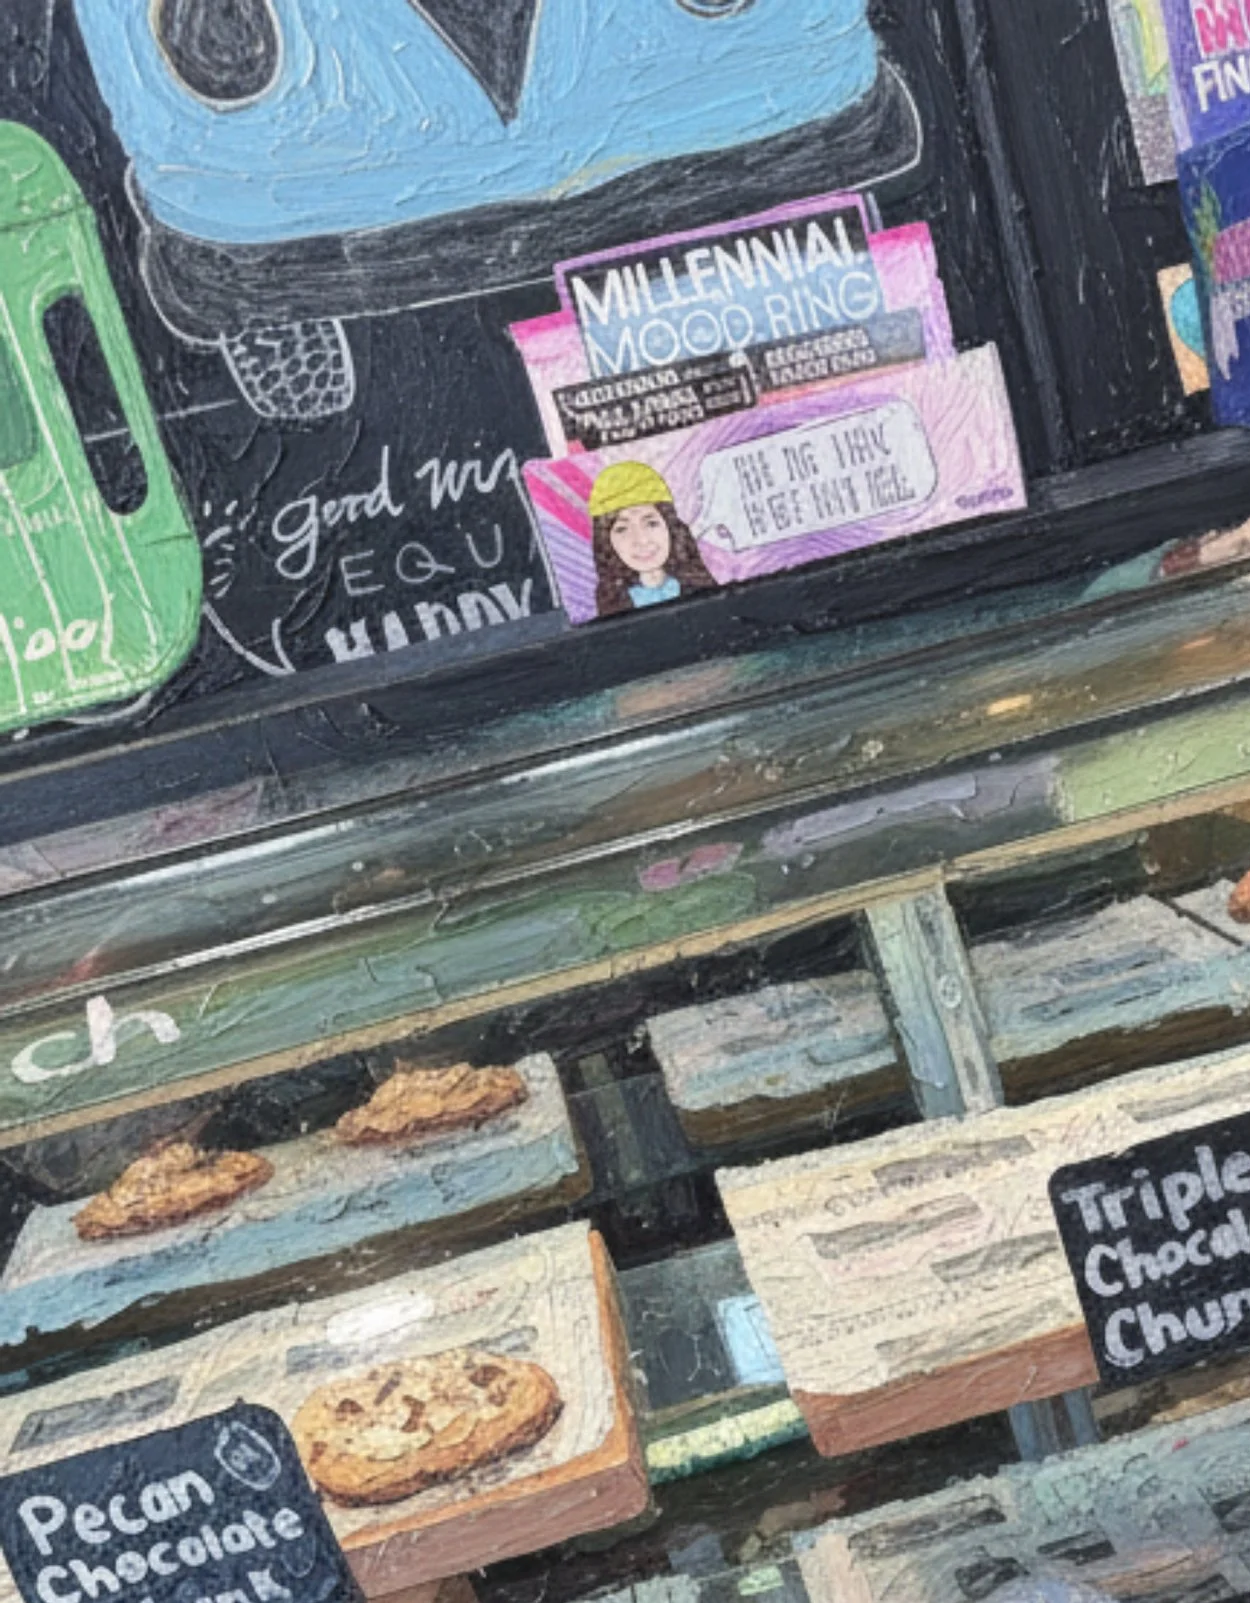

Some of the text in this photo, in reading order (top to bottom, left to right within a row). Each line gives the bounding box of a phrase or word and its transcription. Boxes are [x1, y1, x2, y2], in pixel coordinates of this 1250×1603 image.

[571, 216, 858, 326] MILLENNIAL
[587, 305, 755, 376] MOOD
[765, 272, 878, 334] RING
[272, 444, 404, 580] good
[17, 1469, 217, 1557] Pecan
